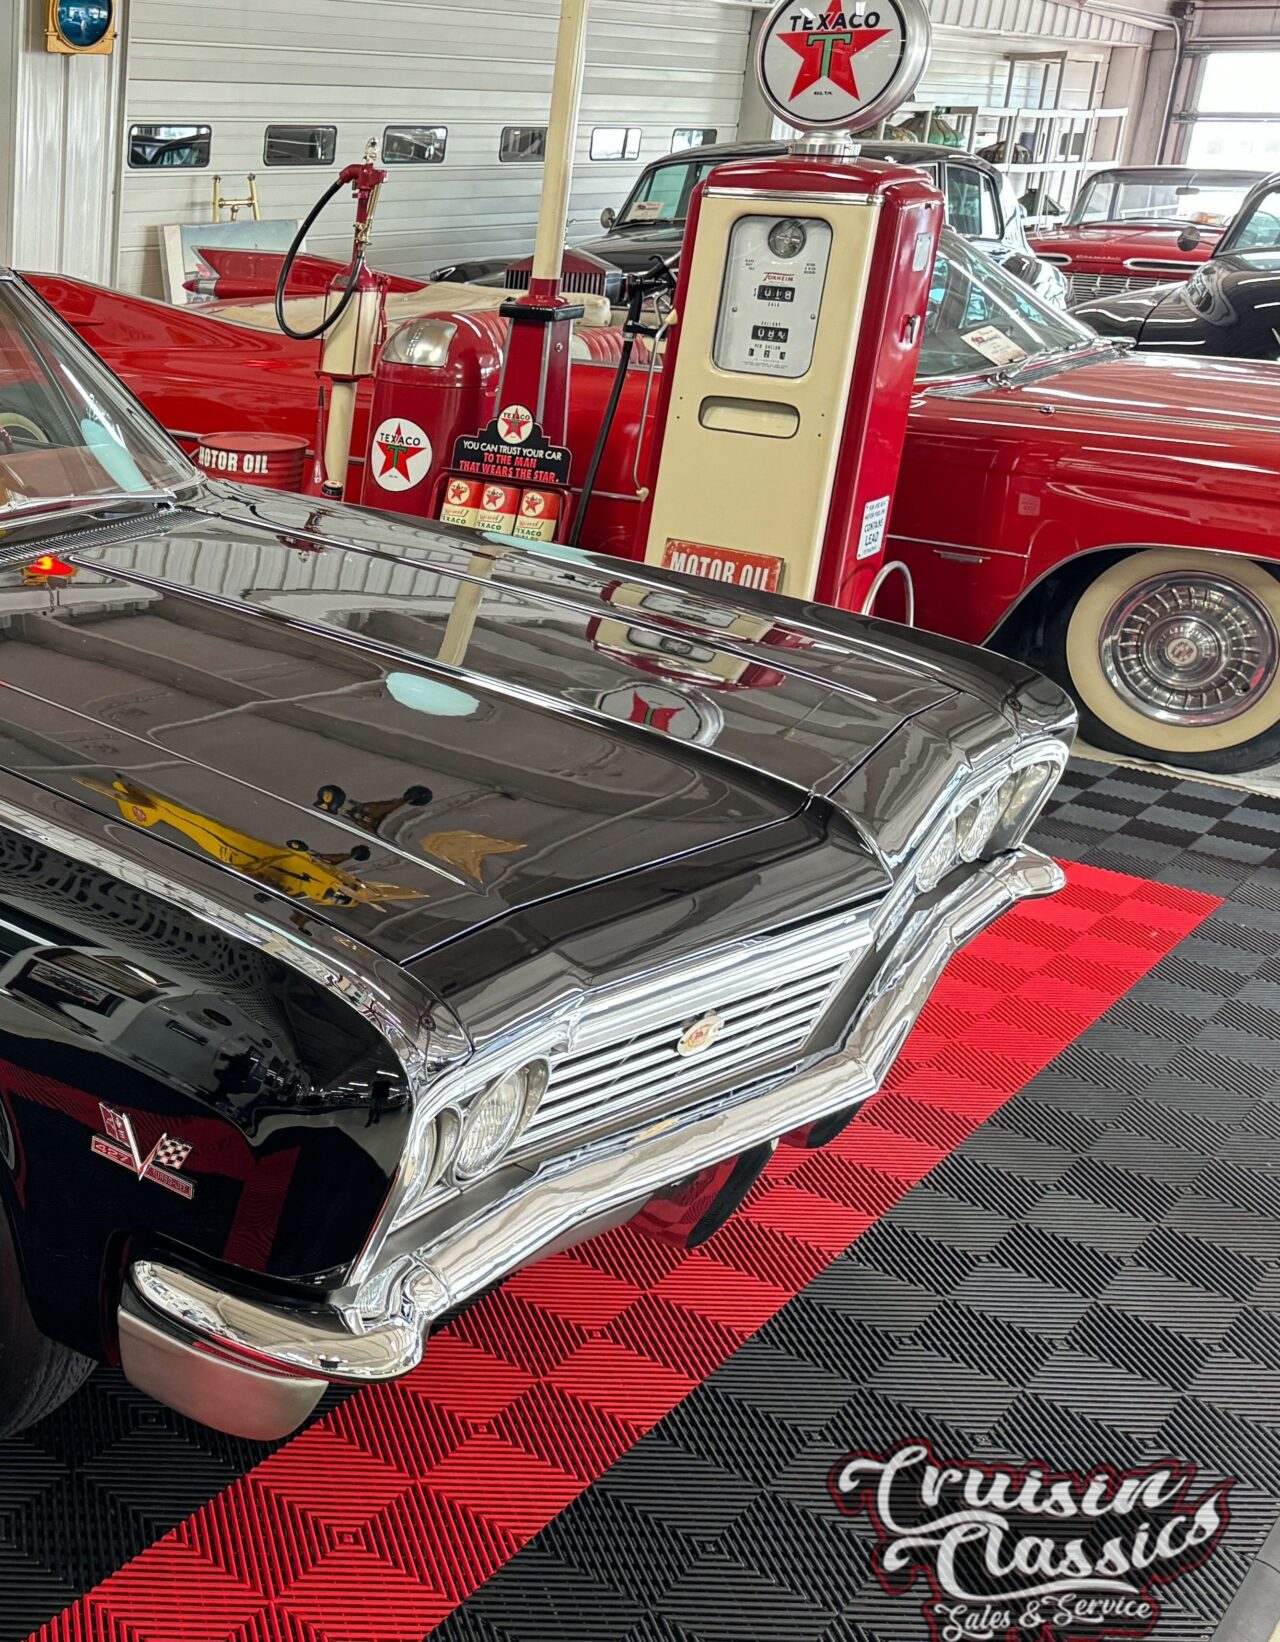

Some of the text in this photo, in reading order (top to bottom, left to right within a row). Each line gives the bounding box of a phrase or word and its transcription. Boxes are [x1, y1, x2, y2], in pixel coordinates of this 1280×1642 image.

[790, 12, 880, 31] TEXACO
[503, 412, 531, 420] TEXACO
[380, 432, 421, 446] TEXACO
[463, 440, 562, 461] YOU CAN TRUST YOUR CAR
[483, 452, 538, 468] TO THE MAN
[243, 454, 269, 474] OIL
[459, 460, 559, 483] THAT WEARS THE STAR.
[864, 531, 879, 546] LEAD
[670, 551, 770, 592] MOTOR OIL
[95, 1143, 130, 1163] 427
